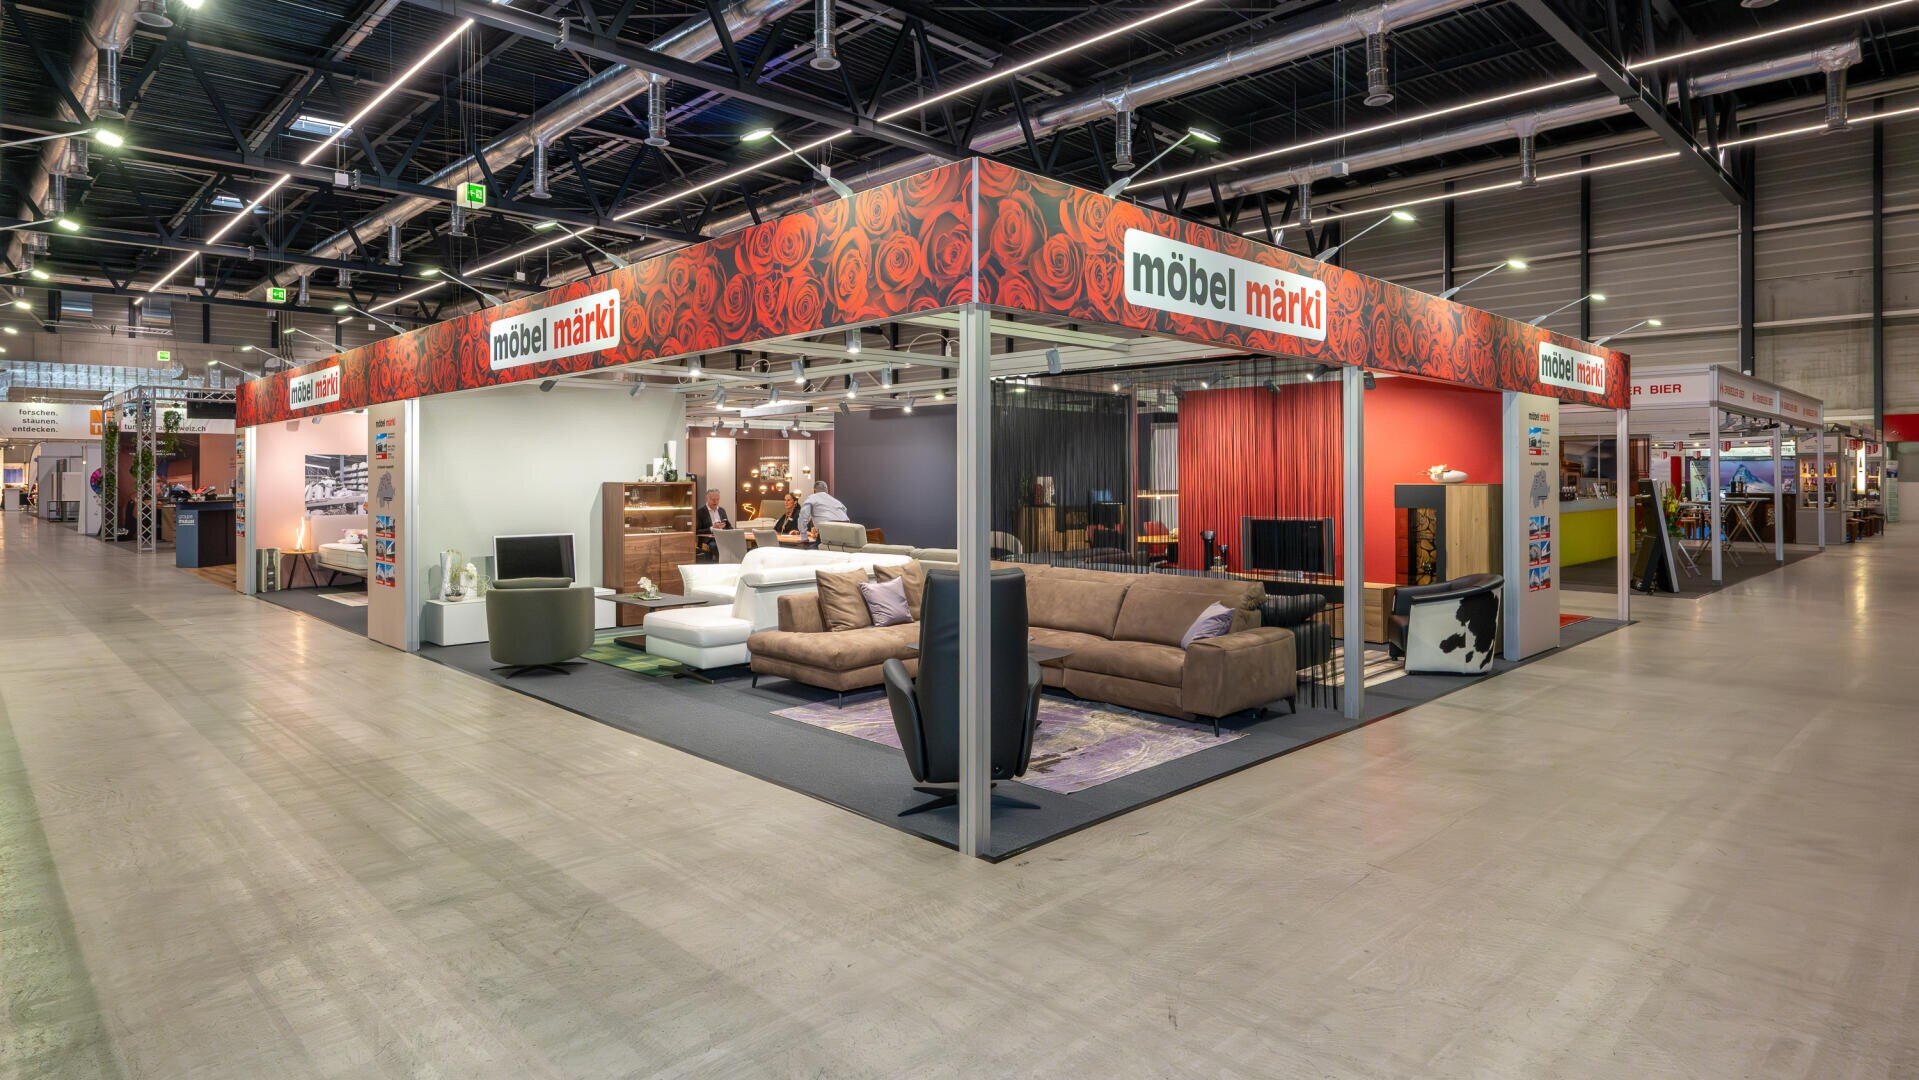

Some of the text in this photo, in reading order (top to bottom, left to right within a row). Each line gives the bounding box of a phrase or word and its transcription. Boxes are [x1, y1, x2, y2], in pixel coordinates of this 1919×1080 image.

[1133, 252, 1321, 329] möbel märki
[494, 299, 615, 361] möbel märki
[291, 371, 338, 404] möbel märki
[1541, 352, 1603, 388] möbel märki
[1650, 384, 1681, 394] BIER
